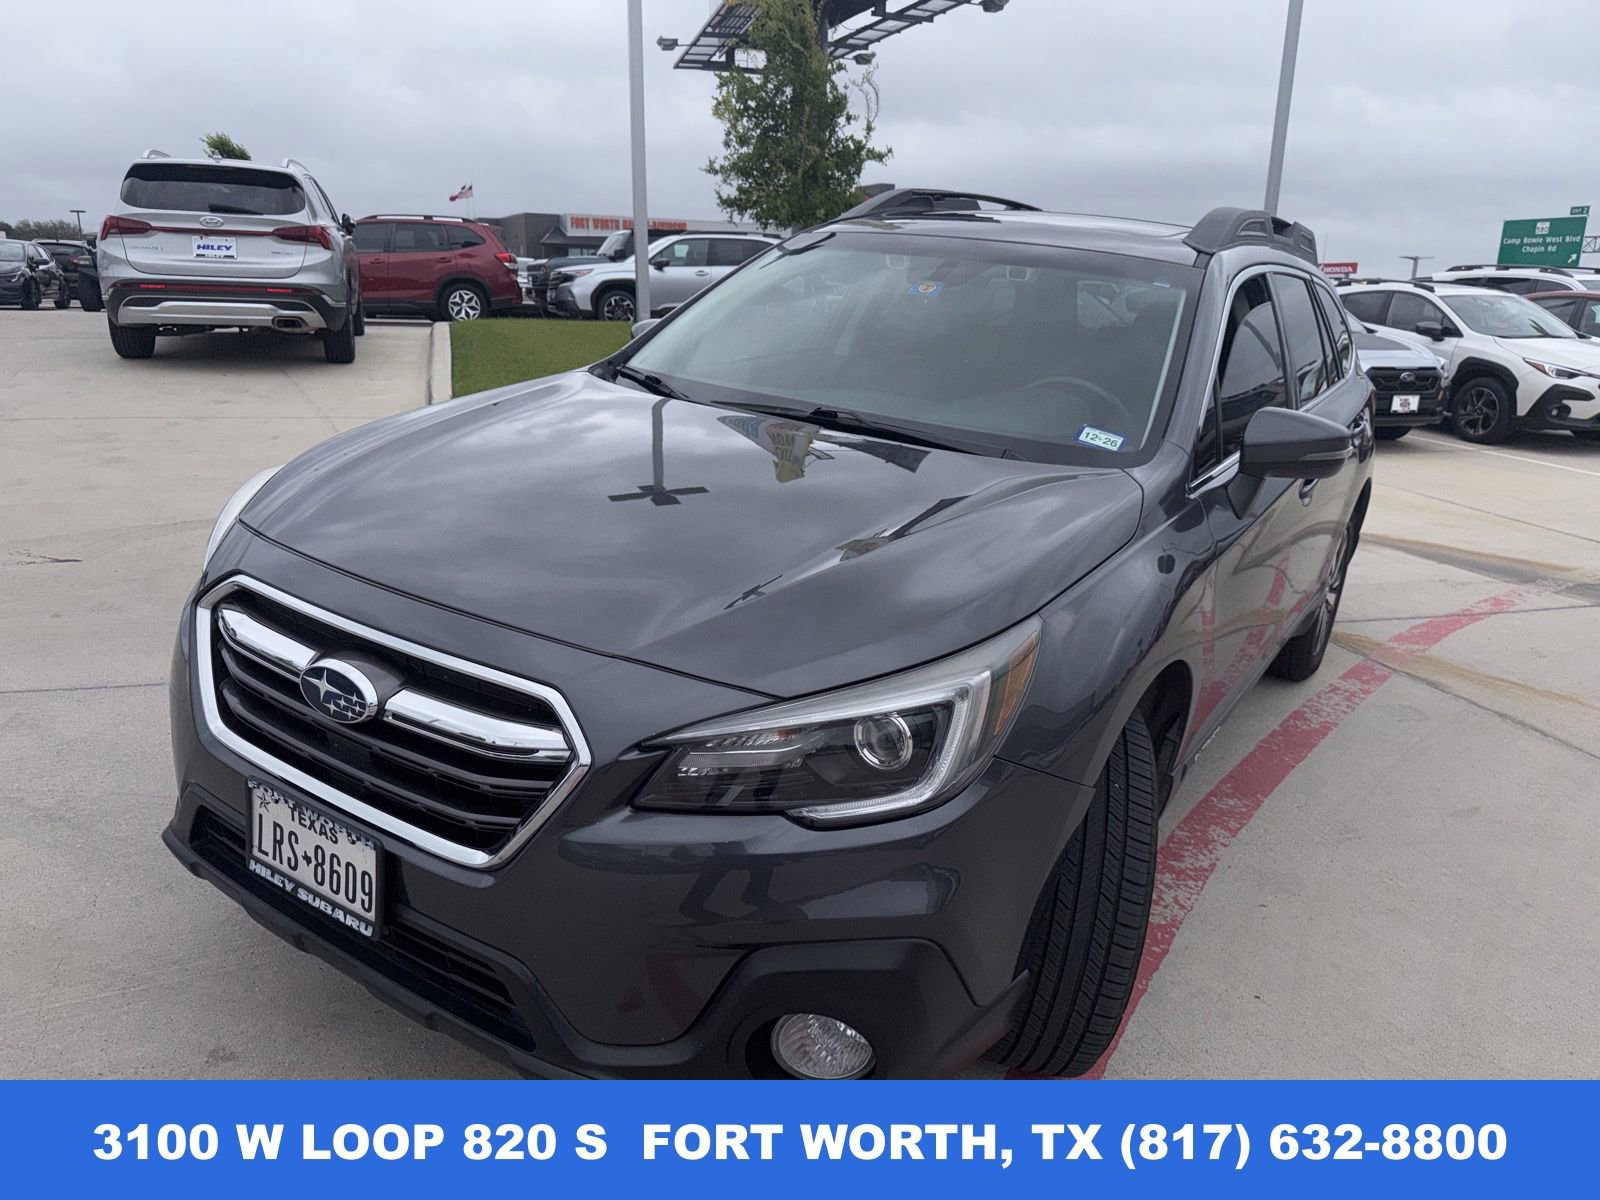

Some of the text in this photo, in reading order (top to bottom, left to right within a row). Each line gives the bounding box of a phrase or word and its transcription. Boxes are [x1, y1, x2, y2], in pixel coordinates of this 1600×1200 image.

[570, 216, 590, 229] FORT
[1522, 245, 1545, 254] Chapin
[287, 804, 339, 845] TEXAS
[248, 858, 374, 937] HILEY SUBARU
